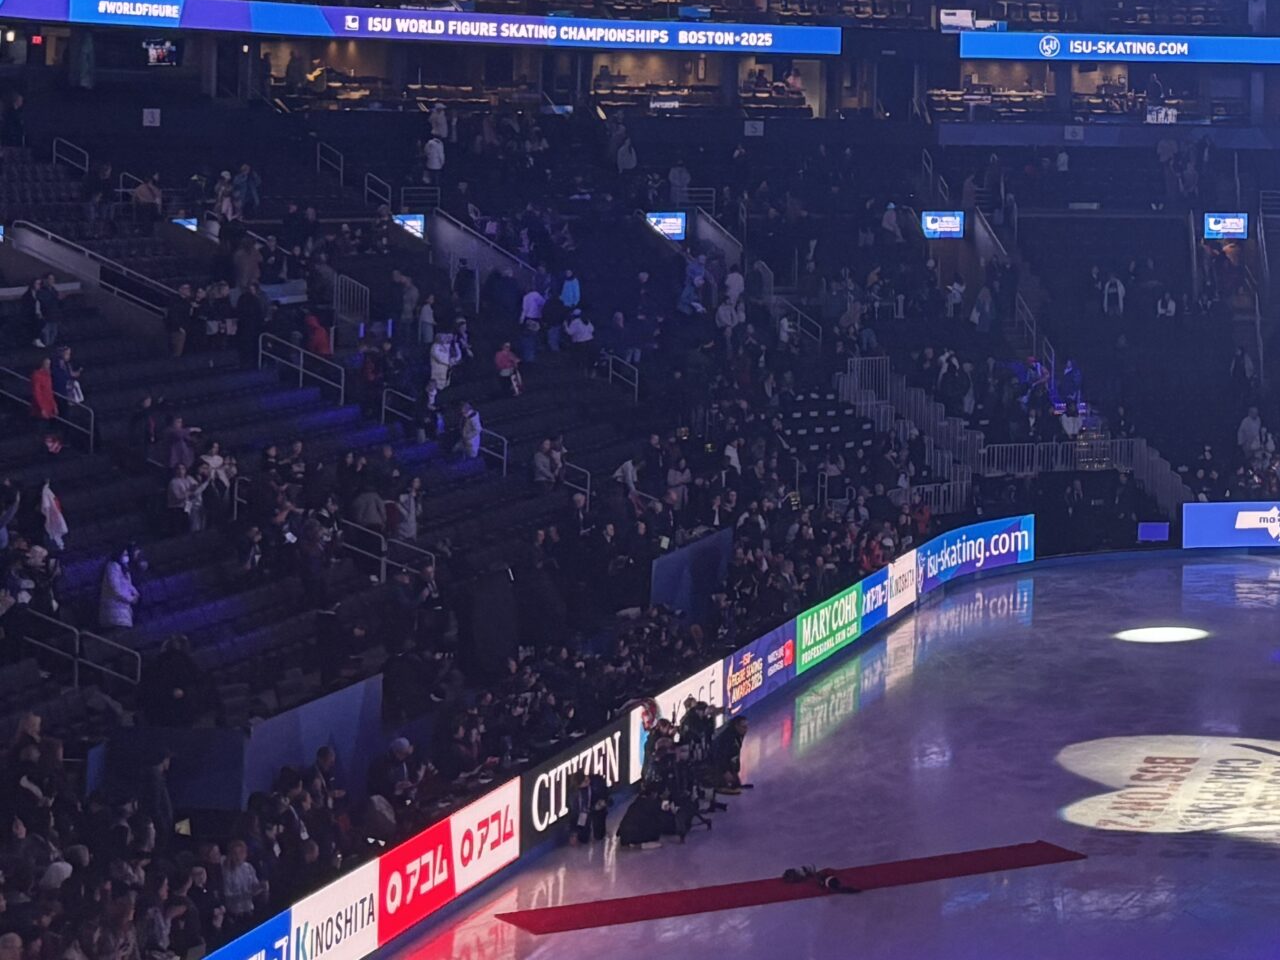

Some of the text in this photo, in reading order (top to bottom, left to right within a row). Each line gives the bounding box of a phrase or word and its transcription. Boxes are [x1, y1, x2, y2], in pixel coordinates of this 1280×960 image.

[98, 0, 179, 18] #WORLDFIGURE
[368, 17, 392, 32] ISU
[396, 19, 445, 35] WORLD
[448, 21, 498, 37] FIGURE
[501, 23, 557, 40] SKATING
[560, 26, 669, 44] CHAMPIONSHIPS
[1069, 40, 1188, 55] ISU-SKATING.COM
[927, 528, 1029, 578] isu-skating.com
[802, 590, 857, 650] MARY COHR
[295, 893, 375, 960] KINOSHITA
